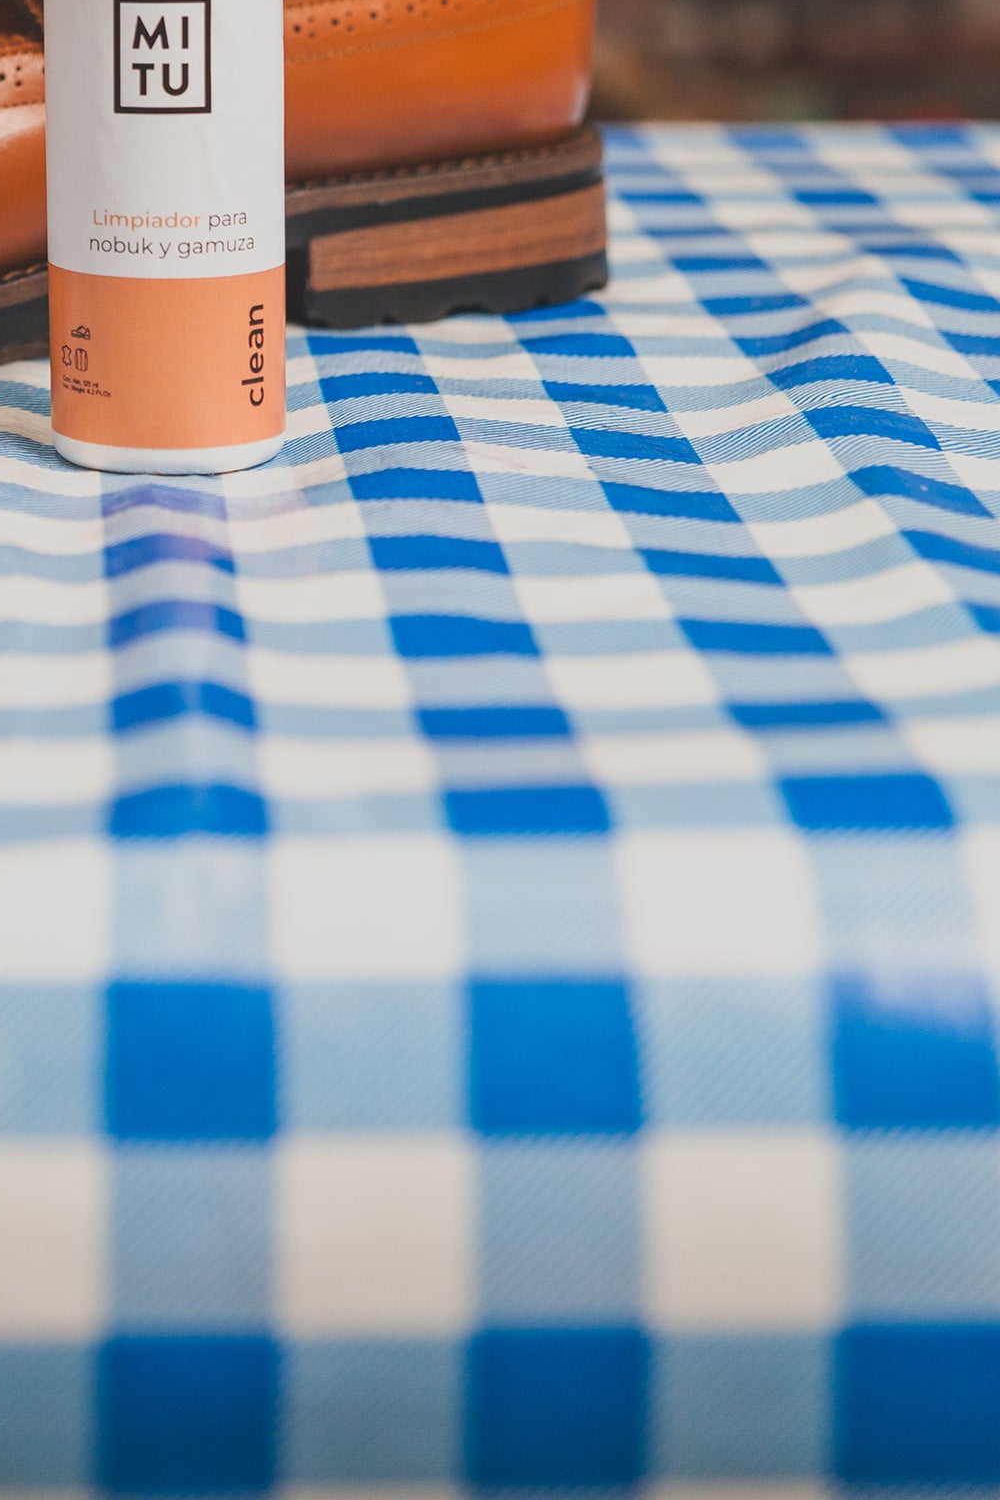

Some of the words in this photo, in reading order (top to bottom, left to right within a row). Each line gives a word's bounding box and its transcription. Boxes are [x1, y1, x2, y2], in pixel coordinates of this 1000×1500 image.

[132, 16, 189, 50] MI
[132, 63, 189, 96] TU
[93, 209, 201, 231] Limpiador
[208, 212, 247, 231] para
[89, 236, 154, 255] nobuk
[159, 242, 171, 259] y
[177, 236, 255, 259] gamuza
[241, 304, 264, 407] clean
